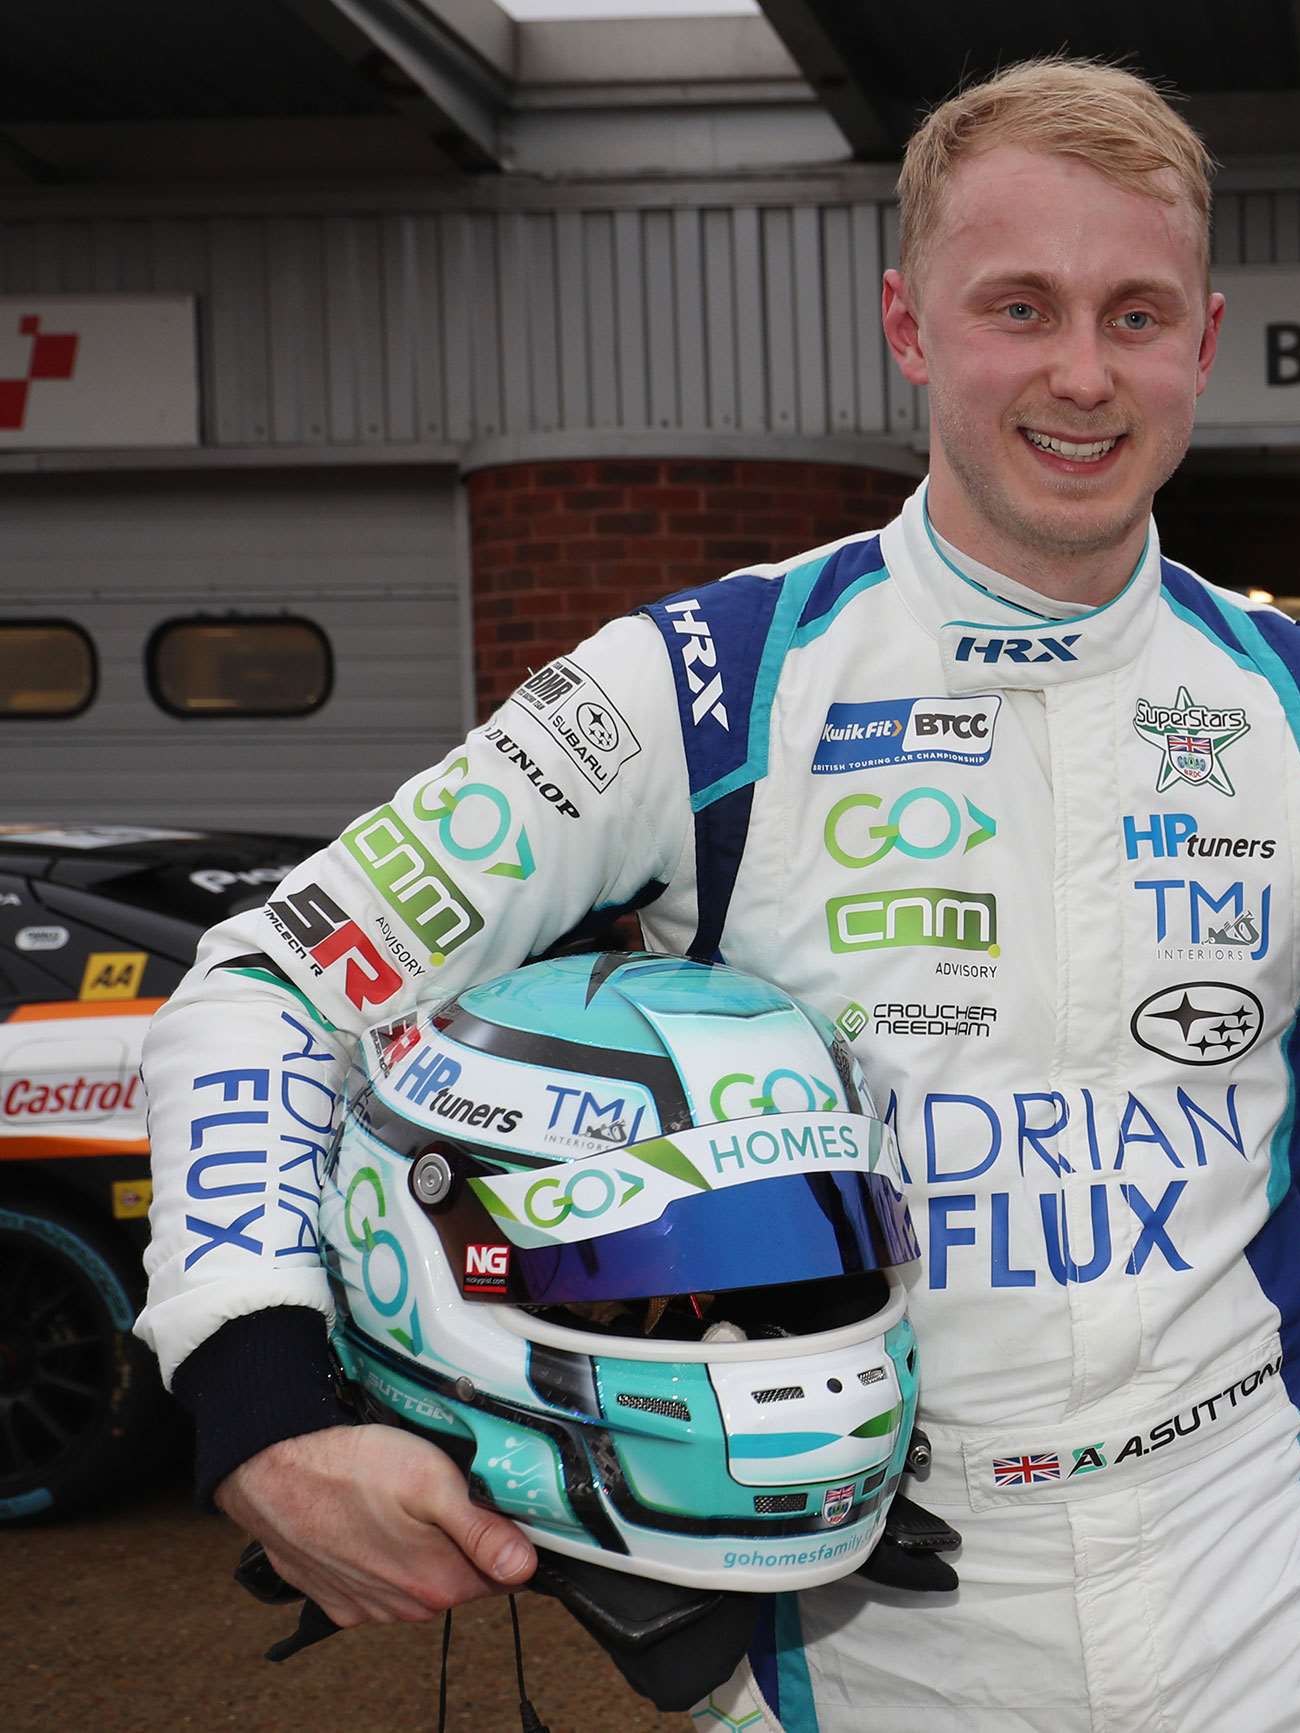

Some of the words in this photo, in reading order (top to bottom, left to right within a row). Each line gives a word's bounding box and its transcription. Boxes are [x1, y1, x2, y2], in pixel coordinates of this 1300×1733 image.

[665, 599, 729, 732] HRX
[954, 634, 1082, 663] HRX
[915, 714, 988, 739] BTCC
[1137, 703, 1242, 728] SuperStars
[553, 715, 607, 780] SUBARU
[849, 756, 891, 768] TOURING
[895, 754, 913, 762] CAR
[917, 753, 985, 763] CHAMPIONSHIP
[485, 729, 580, 819] DUNLOP
[1134, 879, 1272, 960] TMJ
[375, 916, 425, 978] ADVISORY
[1157, 949, 1245, 961] INTERIORS
[92, 964, 131, 990] AA
[935, 962, 998, 979] ADVISORY
[873, 1003, 997, 1023] CROUCHER
[875, 1018, 990, 1038] NEEDHAM
[4, 1076, 139, 1117] Castrol
[709, 1125, 859, 1174] HOMES
[184, 1068, 270, 1272] FLUX
[929, 1180, 1194, 1290] FLUX
[466, 1246, 508, 1274] NG
[1114, 1356, 1282, 1465] A.SUTTON
